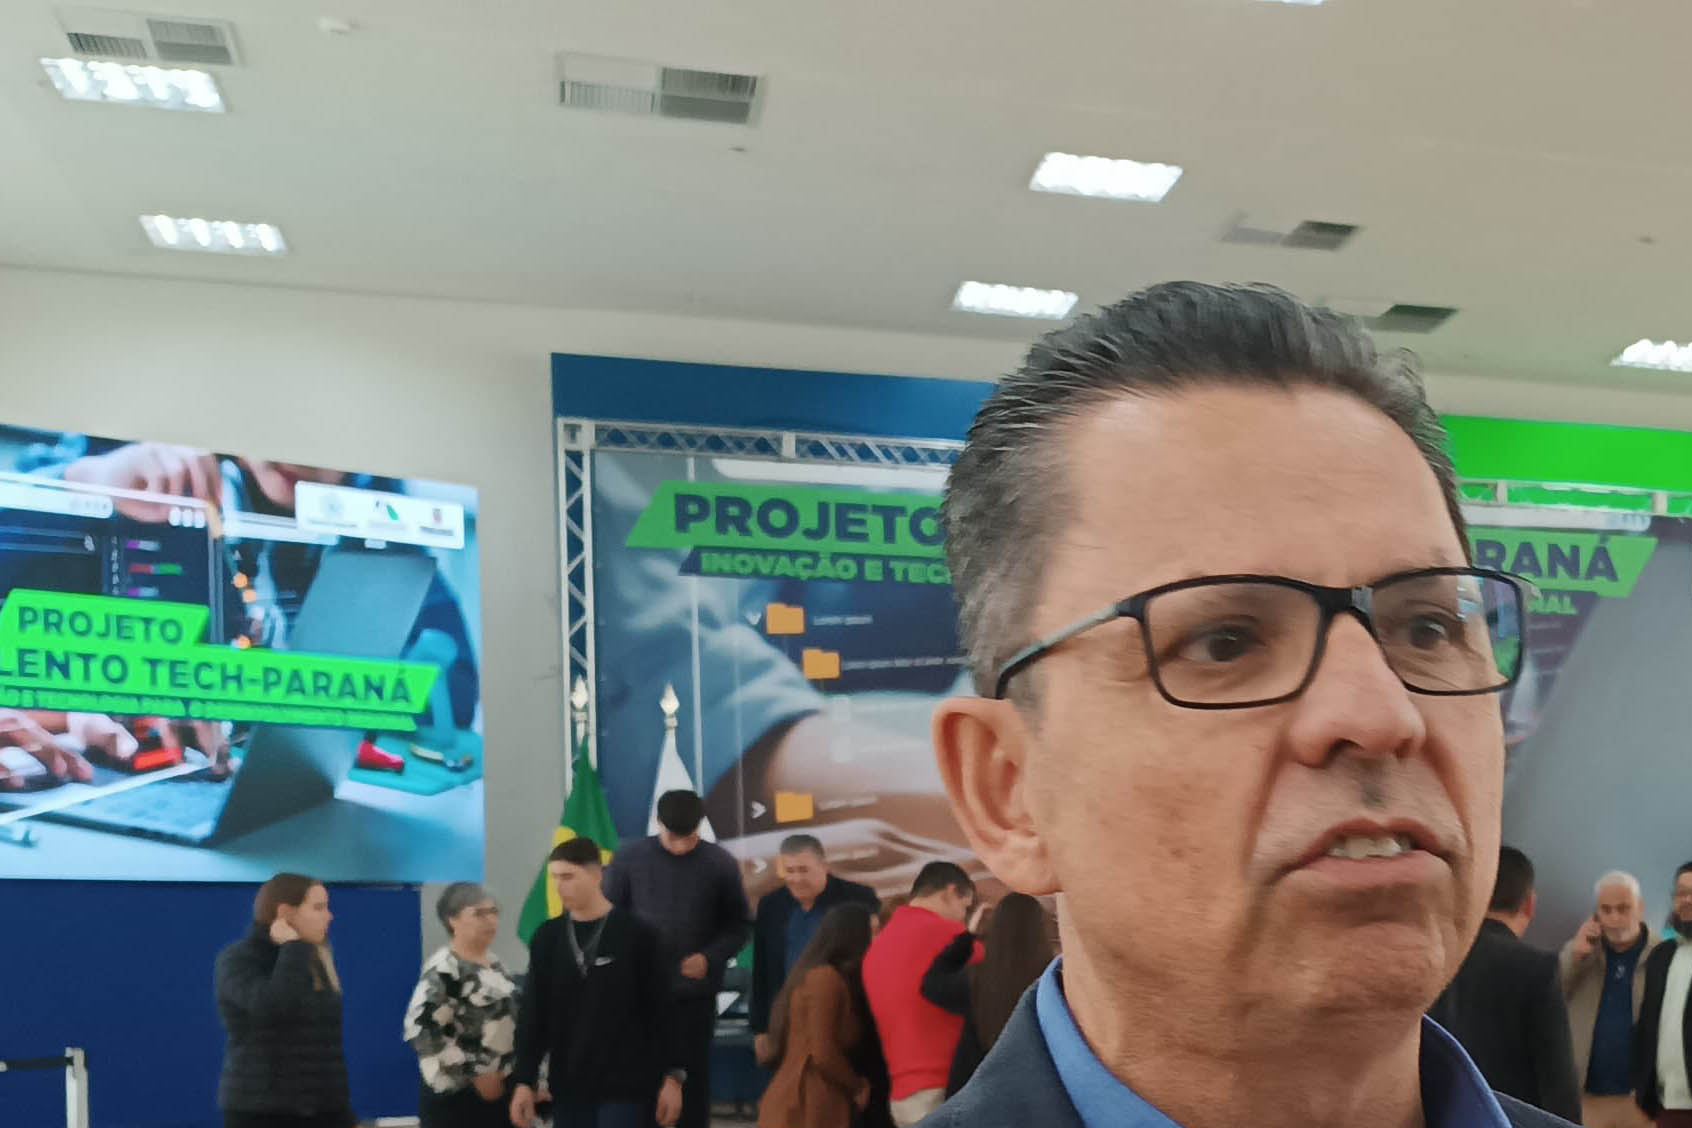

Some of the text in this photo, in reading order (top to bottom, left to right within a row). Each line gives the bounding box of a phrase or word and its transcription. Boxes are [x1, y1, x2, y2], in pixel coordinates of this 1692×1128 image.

[674, 493, 946, 546] PROJETO
[702, 552, 858, 580] INOVAÇÃO
[864, 561, 884, 581] E
[18, 606, 183, 645] PROJETO
[143, 657, 411, 703] TECH-PARANÁ
